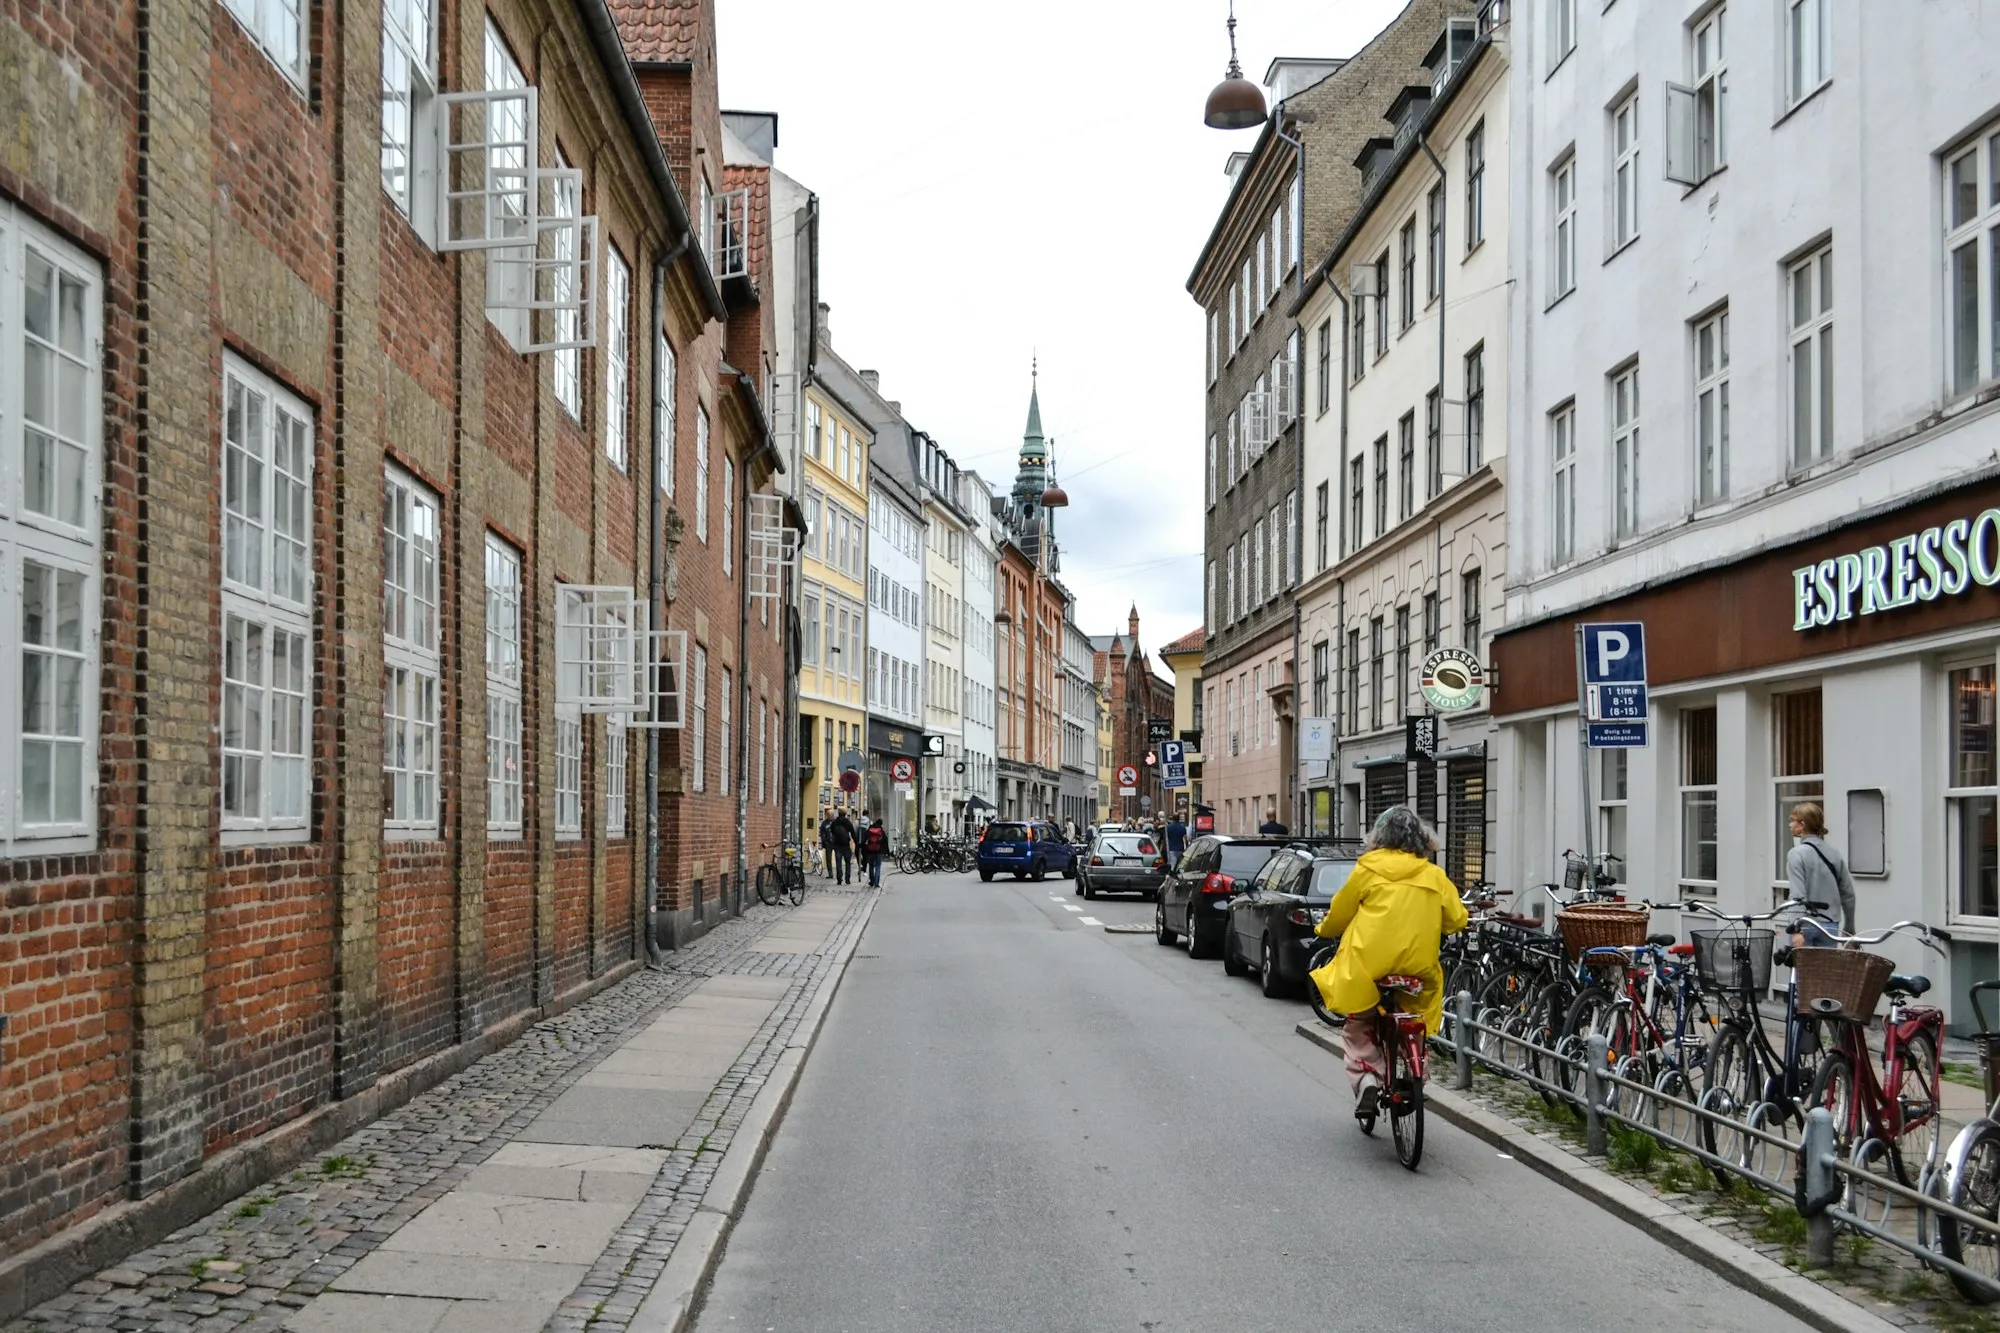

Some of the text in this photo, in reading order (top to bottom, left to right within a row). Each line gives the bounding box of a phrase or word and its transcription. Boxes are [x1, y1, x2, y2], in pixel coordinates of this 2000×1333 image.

[1792, 508, 2000, 631] ESPRESSO
[1597, 630, 1630, 677] P
[1424, 650, 1479, 675] ESPRESSO
[1431, 692, 1474, 707] HOUSE
[1616, 687, 1638, 695] time
[1612, 697, 1634, 706] 8-15
[1609, 707, 1638, 716] (8-15)
[1166, 743, 1179, 762] P
